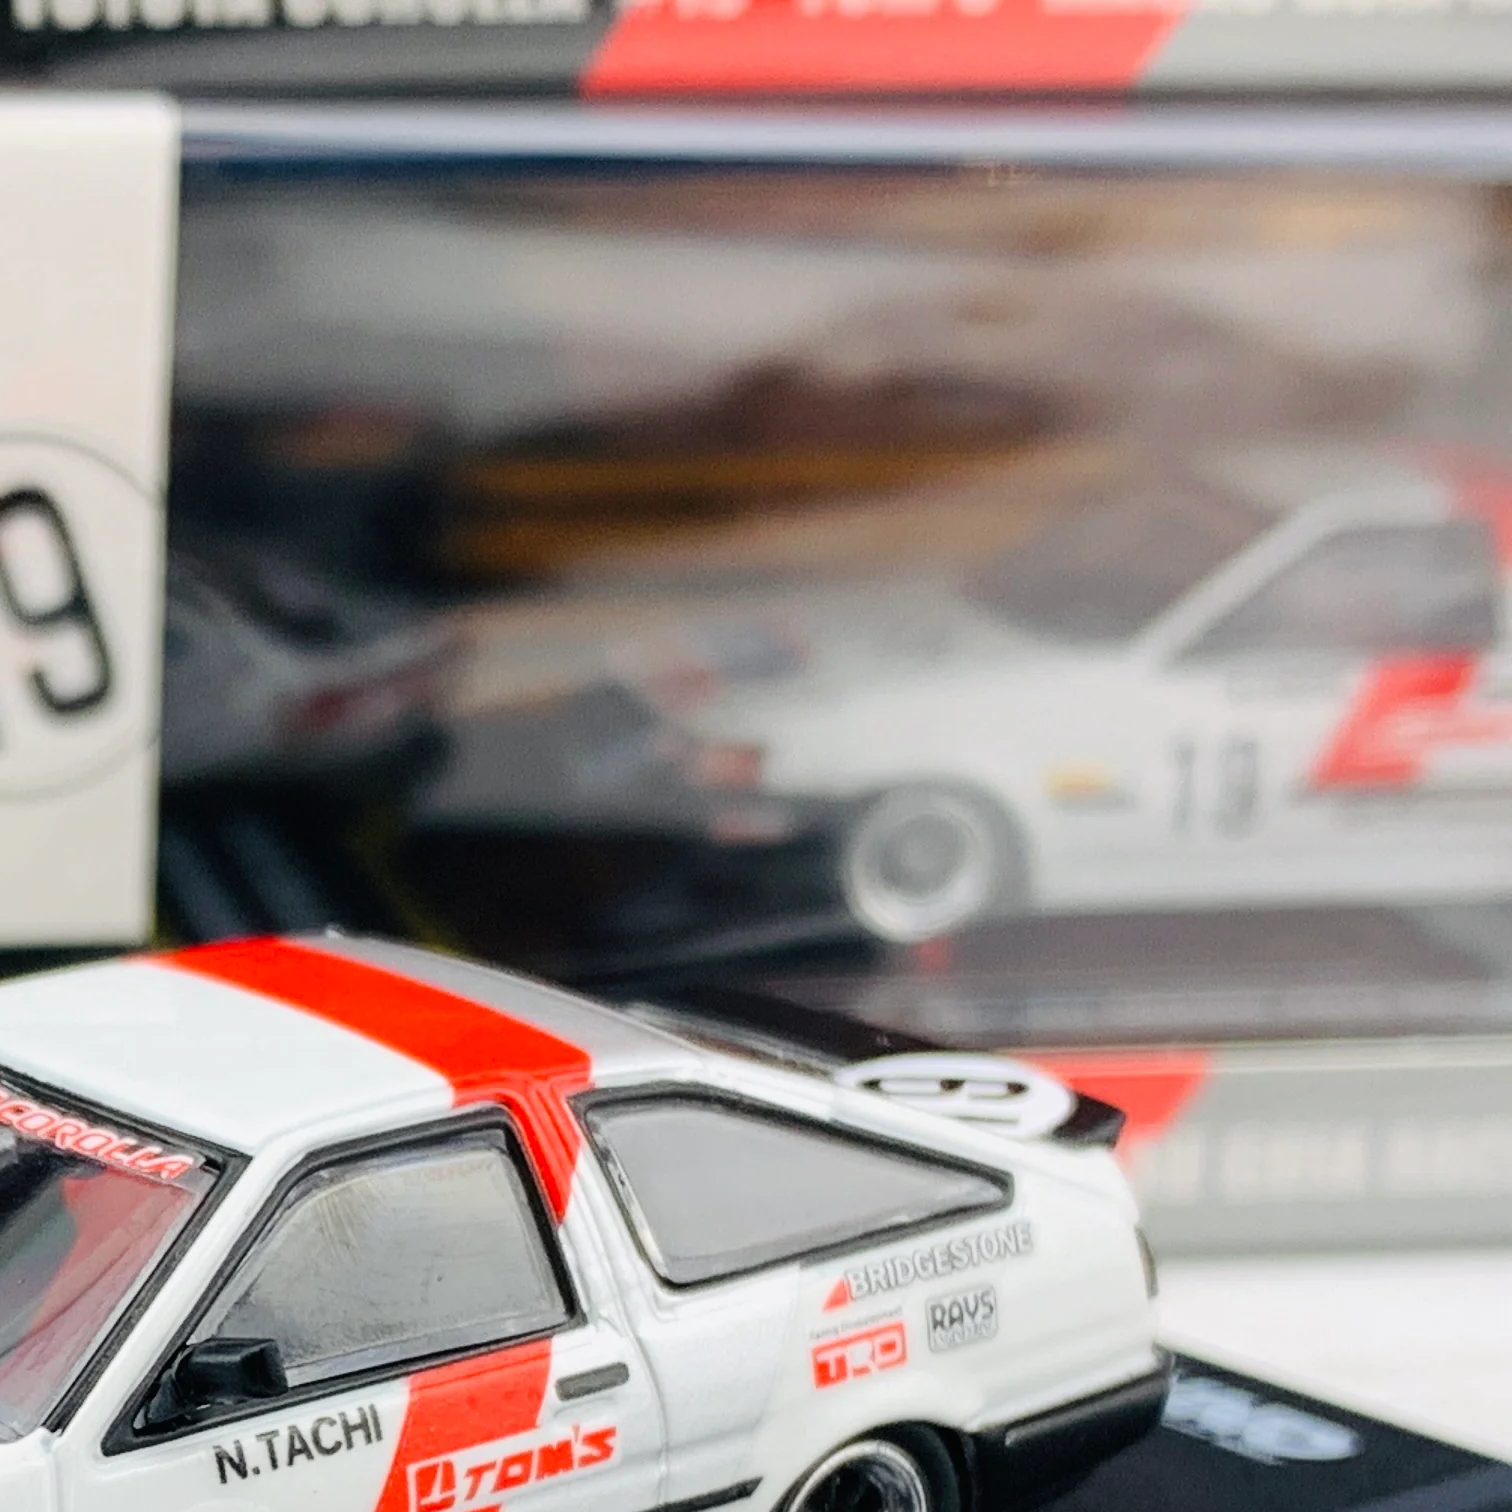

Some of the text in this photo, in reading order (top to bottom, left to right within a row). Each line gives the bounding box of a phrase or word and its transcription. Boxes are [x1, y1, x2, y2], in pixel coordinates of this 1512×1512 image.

[845, 1221, 1034, 1300] BRIDGESTONE
[929, 1291, 994, 1331] RAYS
[813, 1324, 907, 1388] TRD
[212, 1404, 384, 1484] N.TACHI
[464, 1424, 617, 1501] TOM'S
